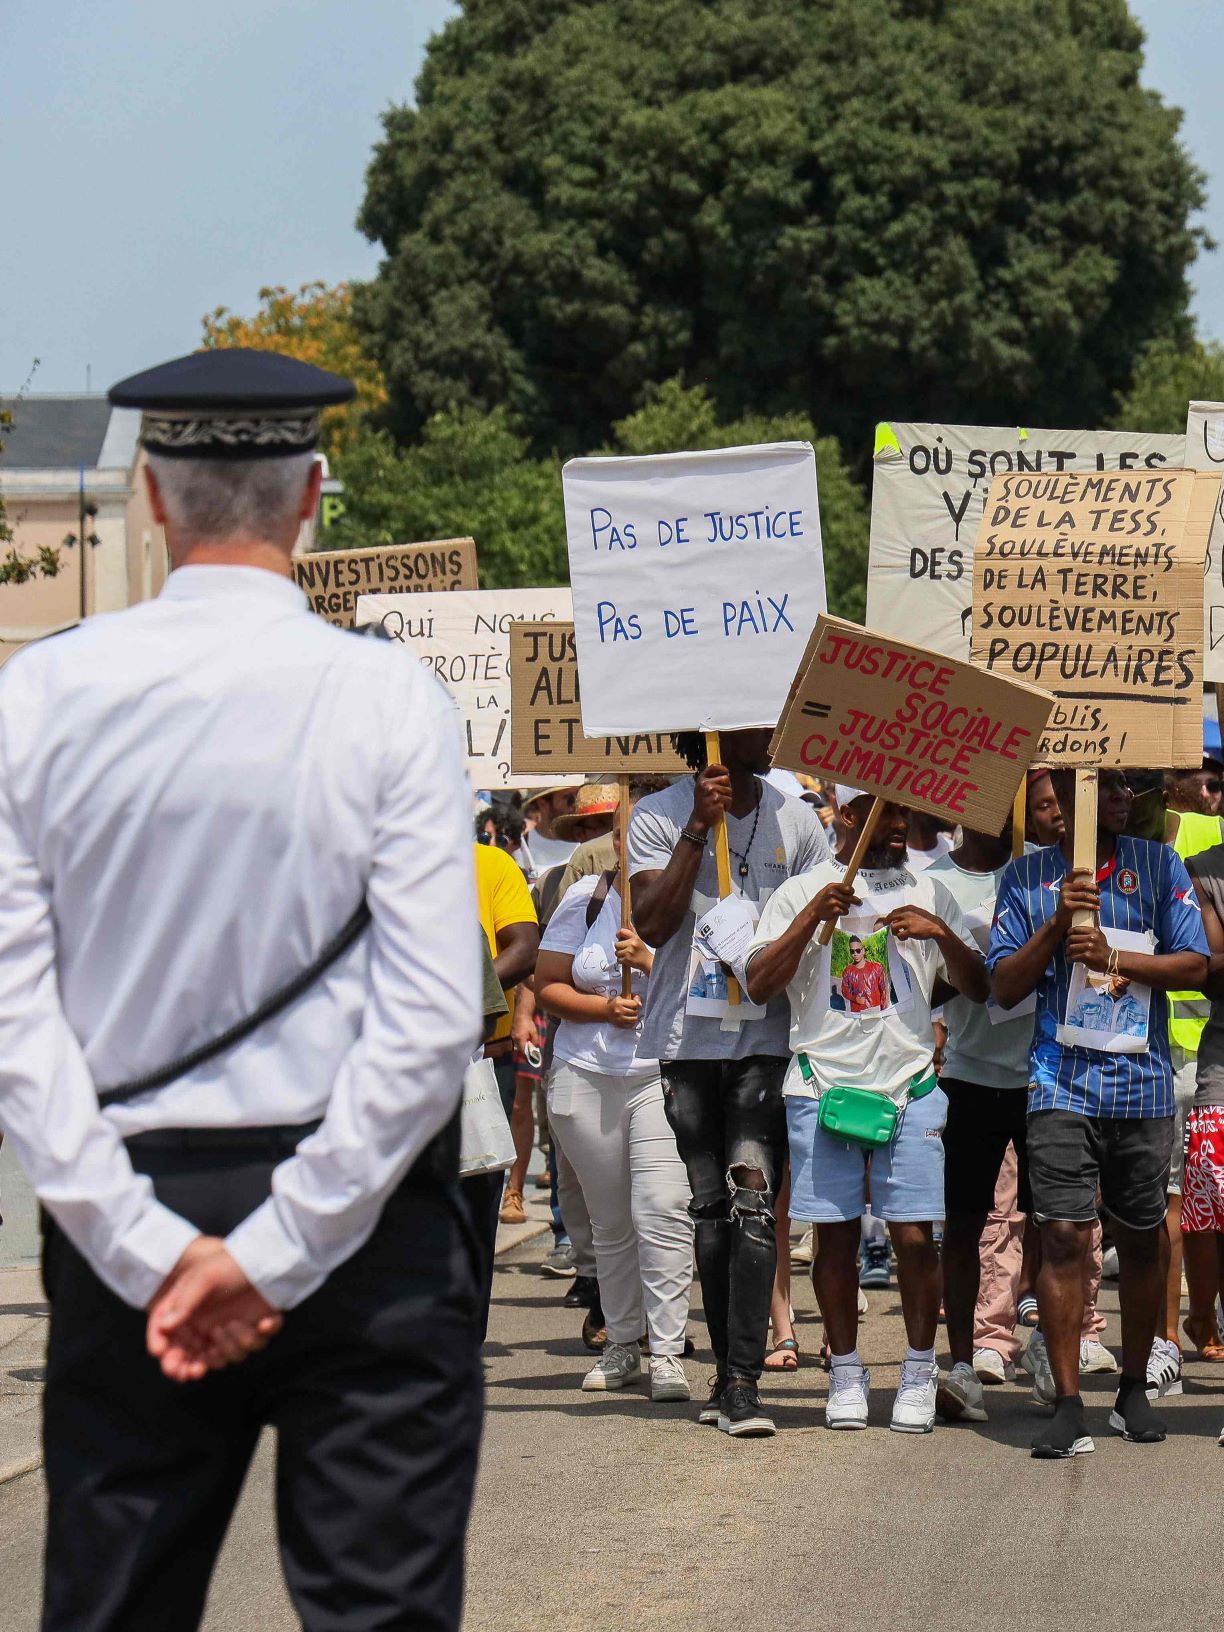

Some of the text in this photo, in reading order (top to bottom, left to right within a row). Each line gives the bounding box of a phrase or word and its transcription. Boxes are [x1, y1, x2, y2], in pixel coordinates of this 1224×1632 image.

[908, 436, 953, 476] OÙ
[967, 449, 1077, 479] SONT
[657, 517, 690, 547] DE
[703, 505, 804, 543] JUSTICE
[990, 504, 1166, 537] DE LA TESS,
[909, 547, 965, 581] DES
[983, 567, 1009, 592] DE
[1017, 564, 1047, 592] LA
[663, 607, 699, 639] DE
[722, 590, 795, 636] PAIX
[819, 635, 956, 697] JUSTICE
[986, 638, 1197, 690] POPULAIRES
[476, 695, 499, 709] LA
[1052, 704, 1108, 732] blis,
[534, 718, 581, 757] ET
[839, 709, 981, 776] JUSTICE
[896, 692, 1031, 759] SOCIALE
[800, 734, 981, 814] CLIMATIQUE
